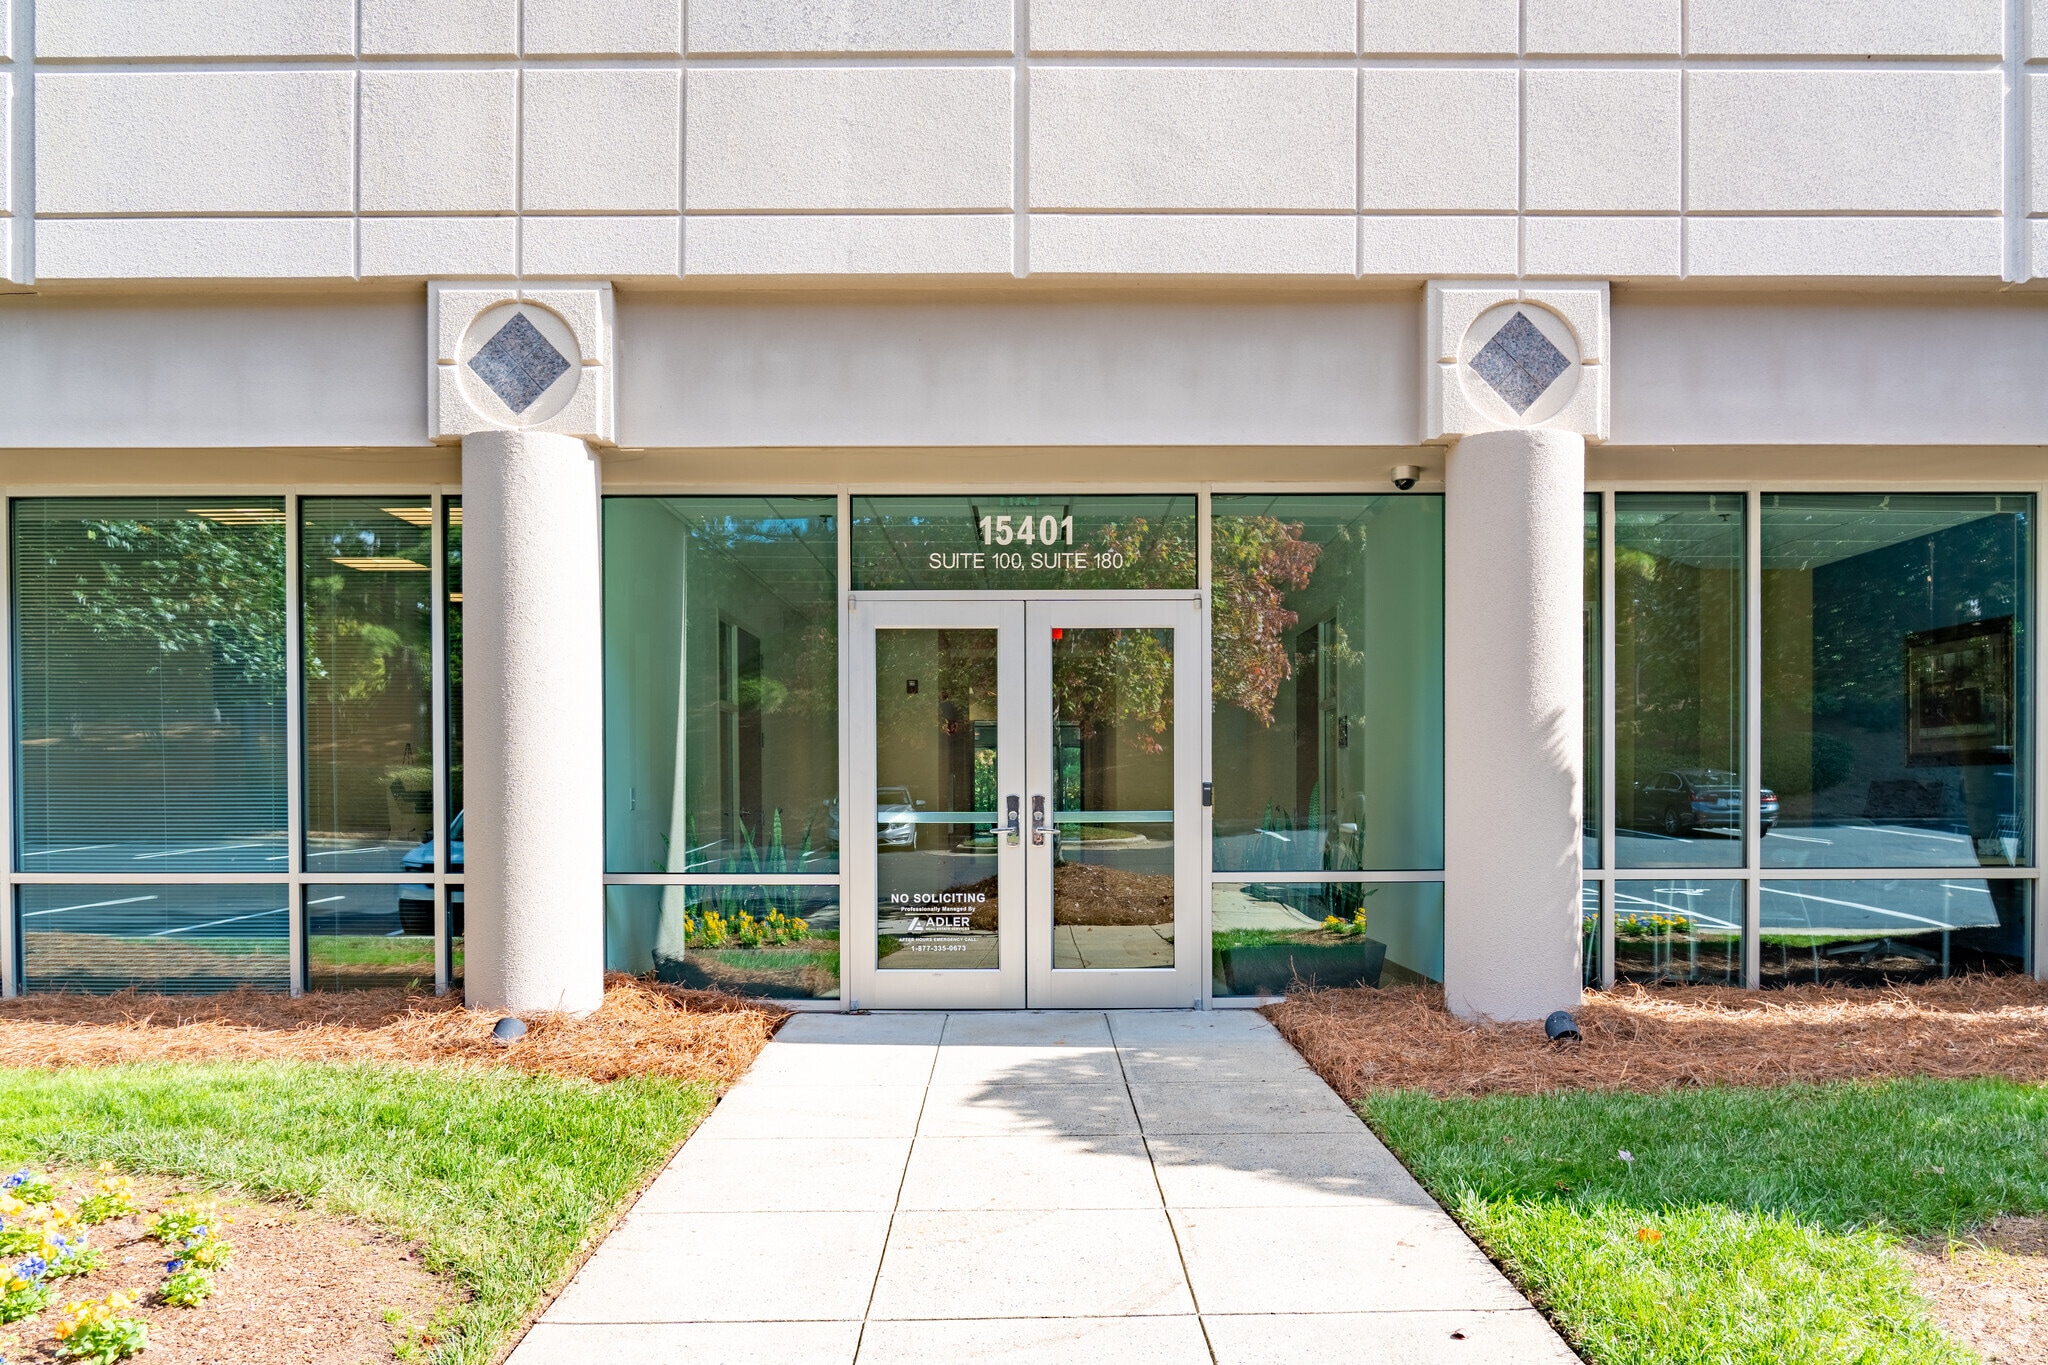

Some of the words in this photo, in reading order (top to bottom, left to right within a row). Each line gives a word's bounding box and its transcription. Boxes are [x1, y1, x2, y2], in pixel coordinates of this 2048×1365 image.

[979, 515, 1074, 545] 15401
[929, 553, 985, 569] SUITE
[992, 553, 1025, 571] 100,
[1031, 553, 1087, 569] SUITE
[1094, 553, 1123, 569] 180
[891, 894, 909, 903] NO
[914, 893, 985, 903] SOLICITING
[926, 917, 970, 926] ADLER
